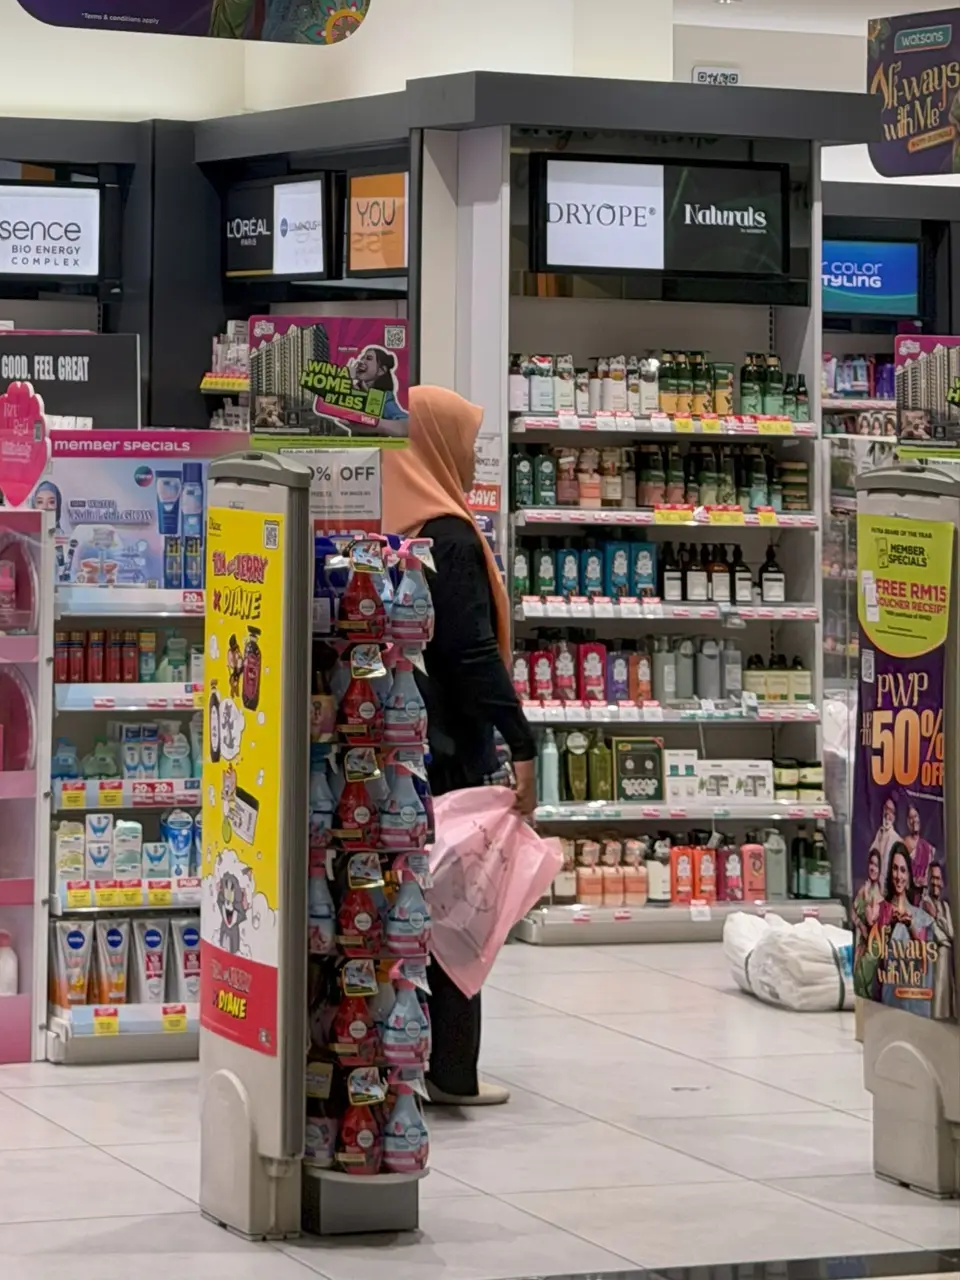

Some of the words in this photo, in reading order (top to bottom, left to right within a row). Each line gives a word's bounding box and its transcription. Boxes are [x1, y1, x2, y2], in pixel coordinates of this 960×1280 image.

[109, 15, 141, 23] conditions
[901, 29, 943, 46] watsons
[356, 200, 396, 227] Y.O.U
[684, 203, 767, 227] Naturals
[227, 218, 271, 238] L'ORÉAL
[12, 245, 31, 254] BIO
[36, 245, 81, 255] ENERGY
[241, 238, 256, 246] PARIS
[11, 257, 80, 266] COMPLEX
[821, 275, 882, 288] TYLING
[1, 355, 30, 381] GOOD.
[34, 356, 56, 381] FEEL
[58, 356, 89, 382] GREAT
[307, 360, 336, 375] WIN
[337, 366, 350, 378] A
[300, 372, 352, 394] HOME
[325, 393, 338, 403] BY
[339, 394, 364, 410] LBS
[340, 466, 375, 481] OFF
[469, 489, 497, 507] SAVE
[890, 543, 925, 556] MEMBER
[888, 554, 927, 567] SPECIALS
[875, 578, 907, 597] FREE
[910, 582, 946, 603] RM15
[222, 586, 262, 620] DIANE
[911, 600, 946, 615] RECEIPT
[876, 671, 929, 708] PWP
[871, 708, 944, 787] 50%
[921, 761, 944, 786] OFF
